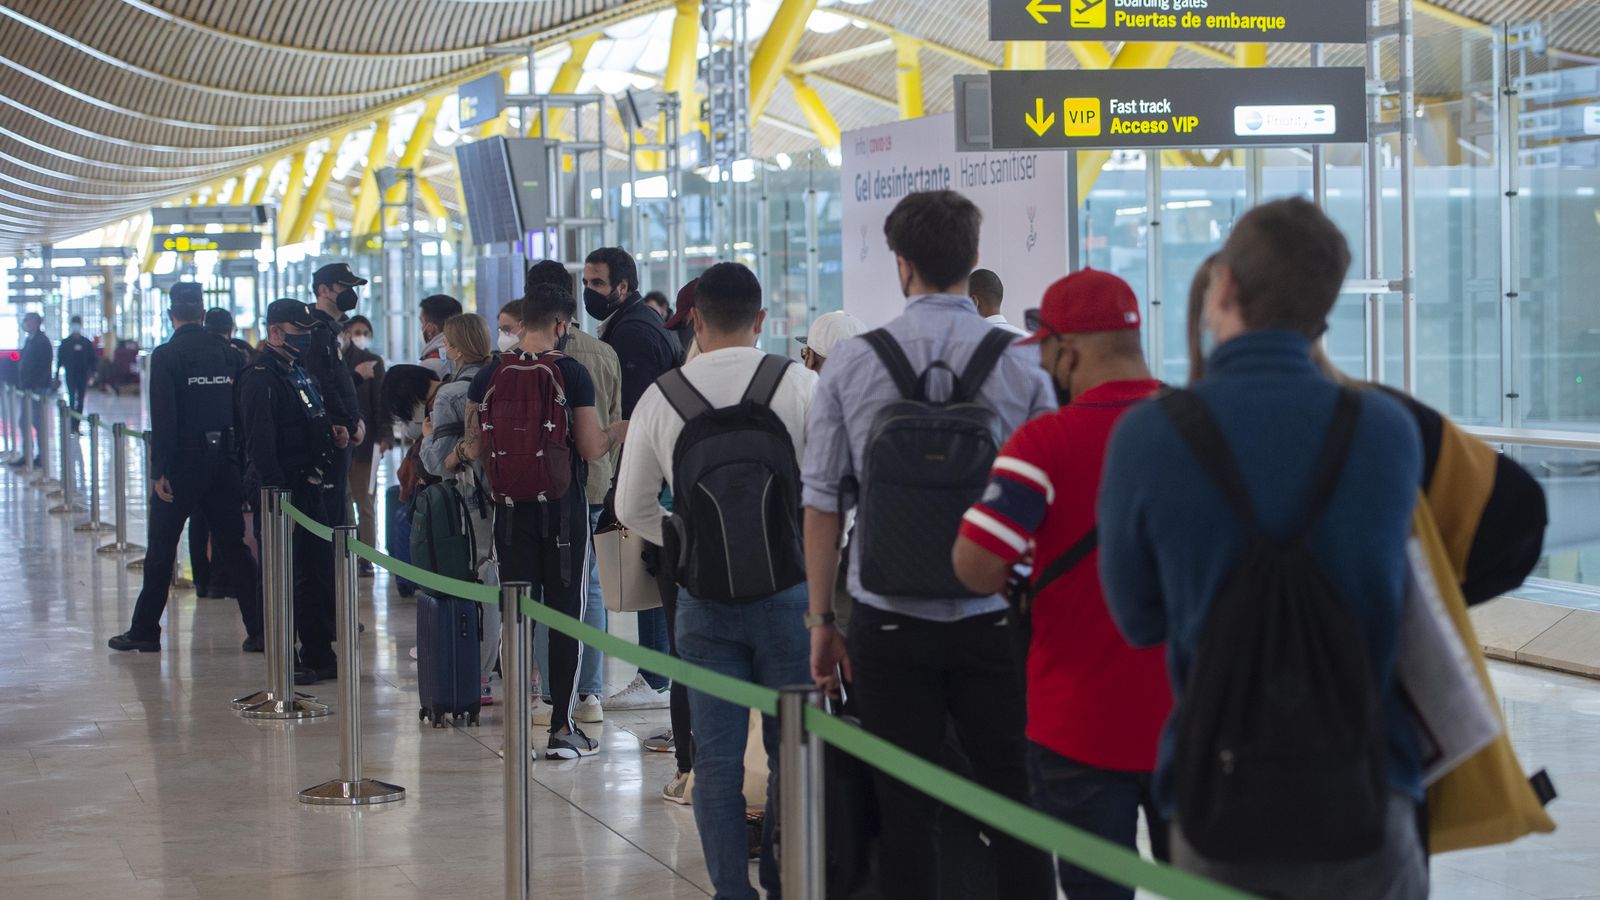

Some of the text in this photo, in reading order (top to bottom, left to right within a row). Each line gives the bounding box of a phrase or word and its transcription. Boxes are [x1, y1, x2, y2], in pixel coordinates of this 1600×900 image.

[1115, 10, 1286, 32] Puertas de embarque
[1110, 98, 1172, 114] Fast track
[1069, 111, 1095, 124] VIP
[1110, 116, 1199, 134] Acceso VIP
[961, 151, 1037, 188] Hand sanitiser
[855, 163, 950, 202] Gel desinfectante
[188, 376, 234, 385] POLICIA
